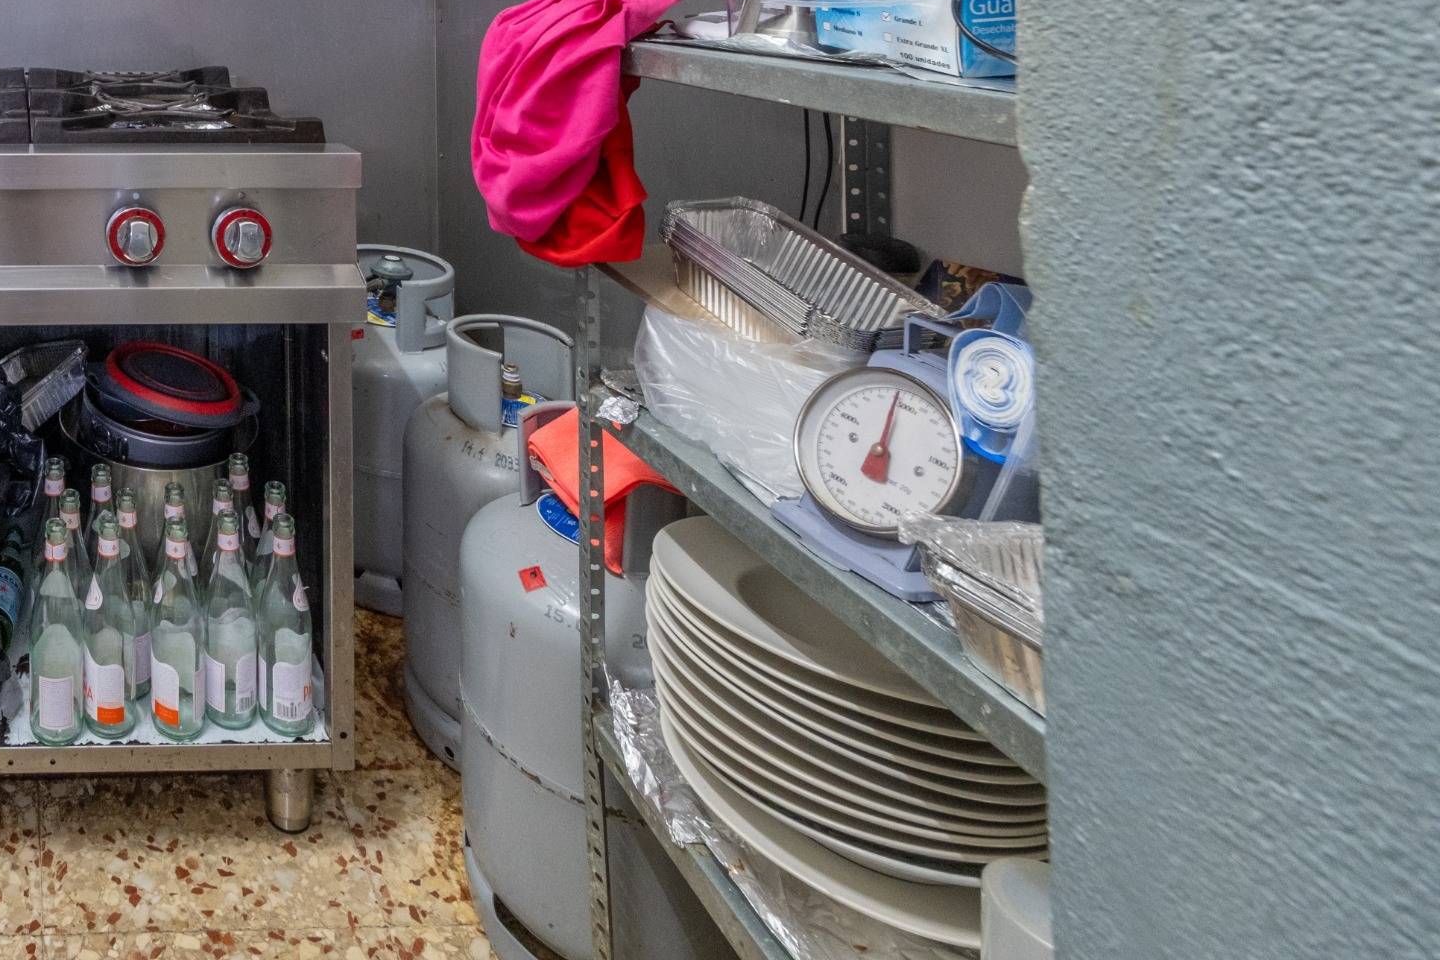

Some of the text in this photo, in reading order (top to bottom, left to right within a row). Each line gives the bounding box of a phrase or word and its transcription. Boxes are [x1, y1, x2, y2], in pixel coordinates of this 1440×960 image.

[894, 16, 917, 25] Grande
[897, 37, 913, 46] Extra
[914, 38, 938, 50] Grande
[900, 52, 951, 70] 100 unidades
[633, 633, 648, 650] 2
